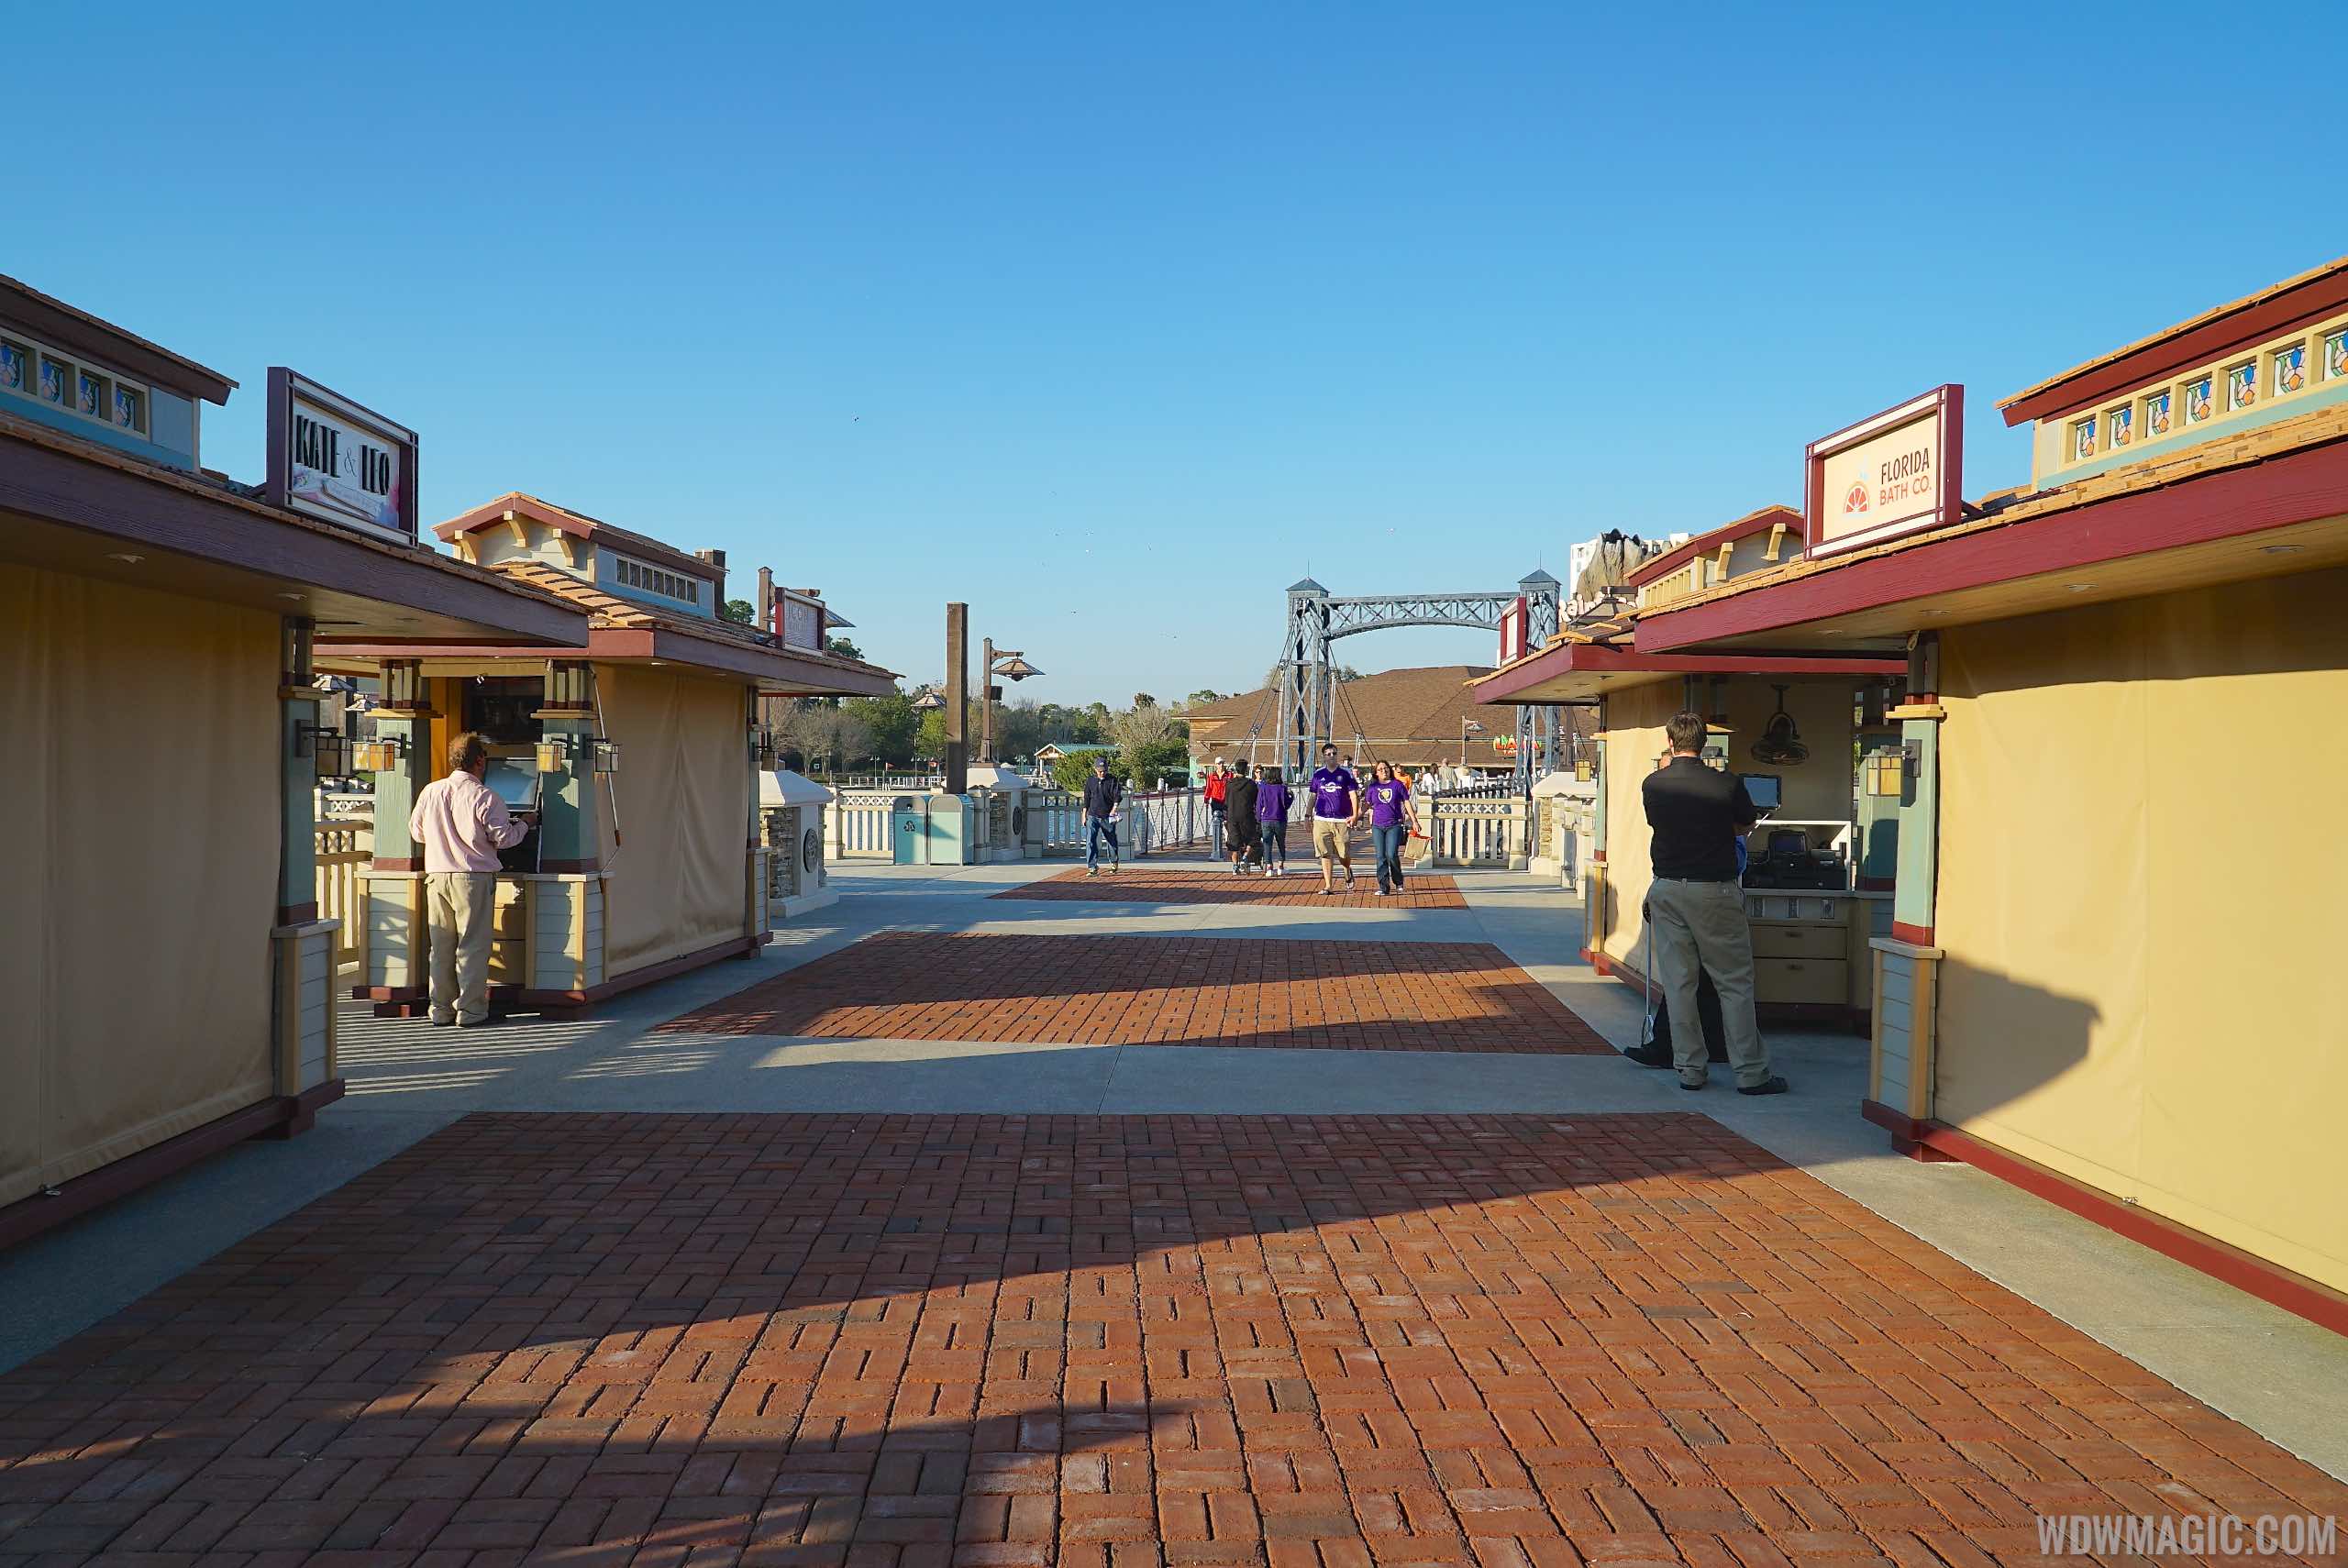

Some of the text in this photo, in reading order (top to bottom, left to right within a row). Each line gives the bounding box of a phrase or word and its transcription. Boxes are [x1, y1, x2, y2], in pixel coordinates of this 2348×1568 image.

[296, 415, 341, 478] KATE
[344, 447, 359, 478] &
[1881, 447, 1930, 485] FLORIDA
[1879, 475, 1933, 506] BATH CO.
